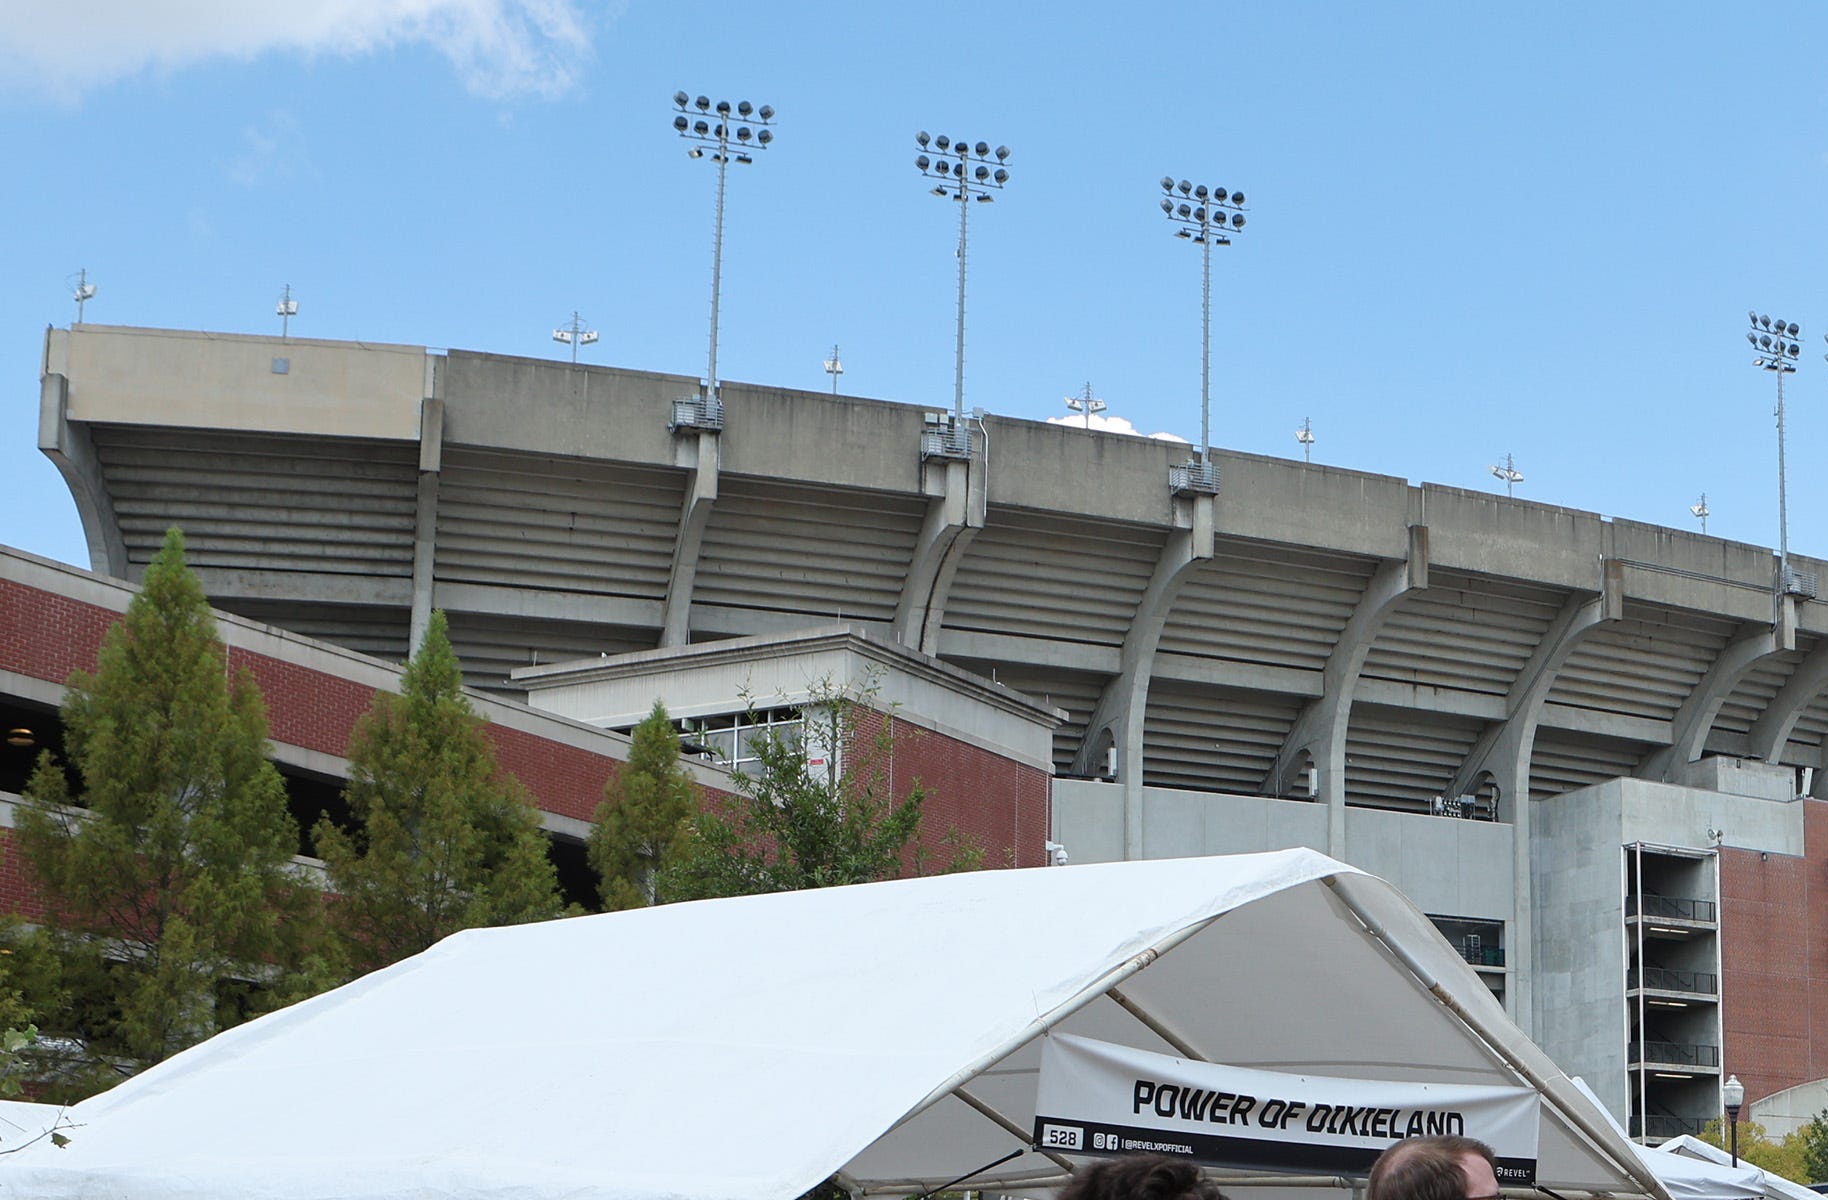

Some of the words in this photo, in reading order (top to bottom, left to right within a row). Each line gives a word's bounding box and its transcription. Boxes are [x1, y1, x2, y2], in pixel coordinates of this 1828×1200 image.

[1133, 1079, 1257, 1127] POWER
[1257, 1098, 1307, 1130] OF
[1306, 1102, 1465, 1140] DIXIELAND
[1049, 1130, 1077, 1146] 528
[1124, 1139, 1194, 1155] @REVELXPOFFICIAL
